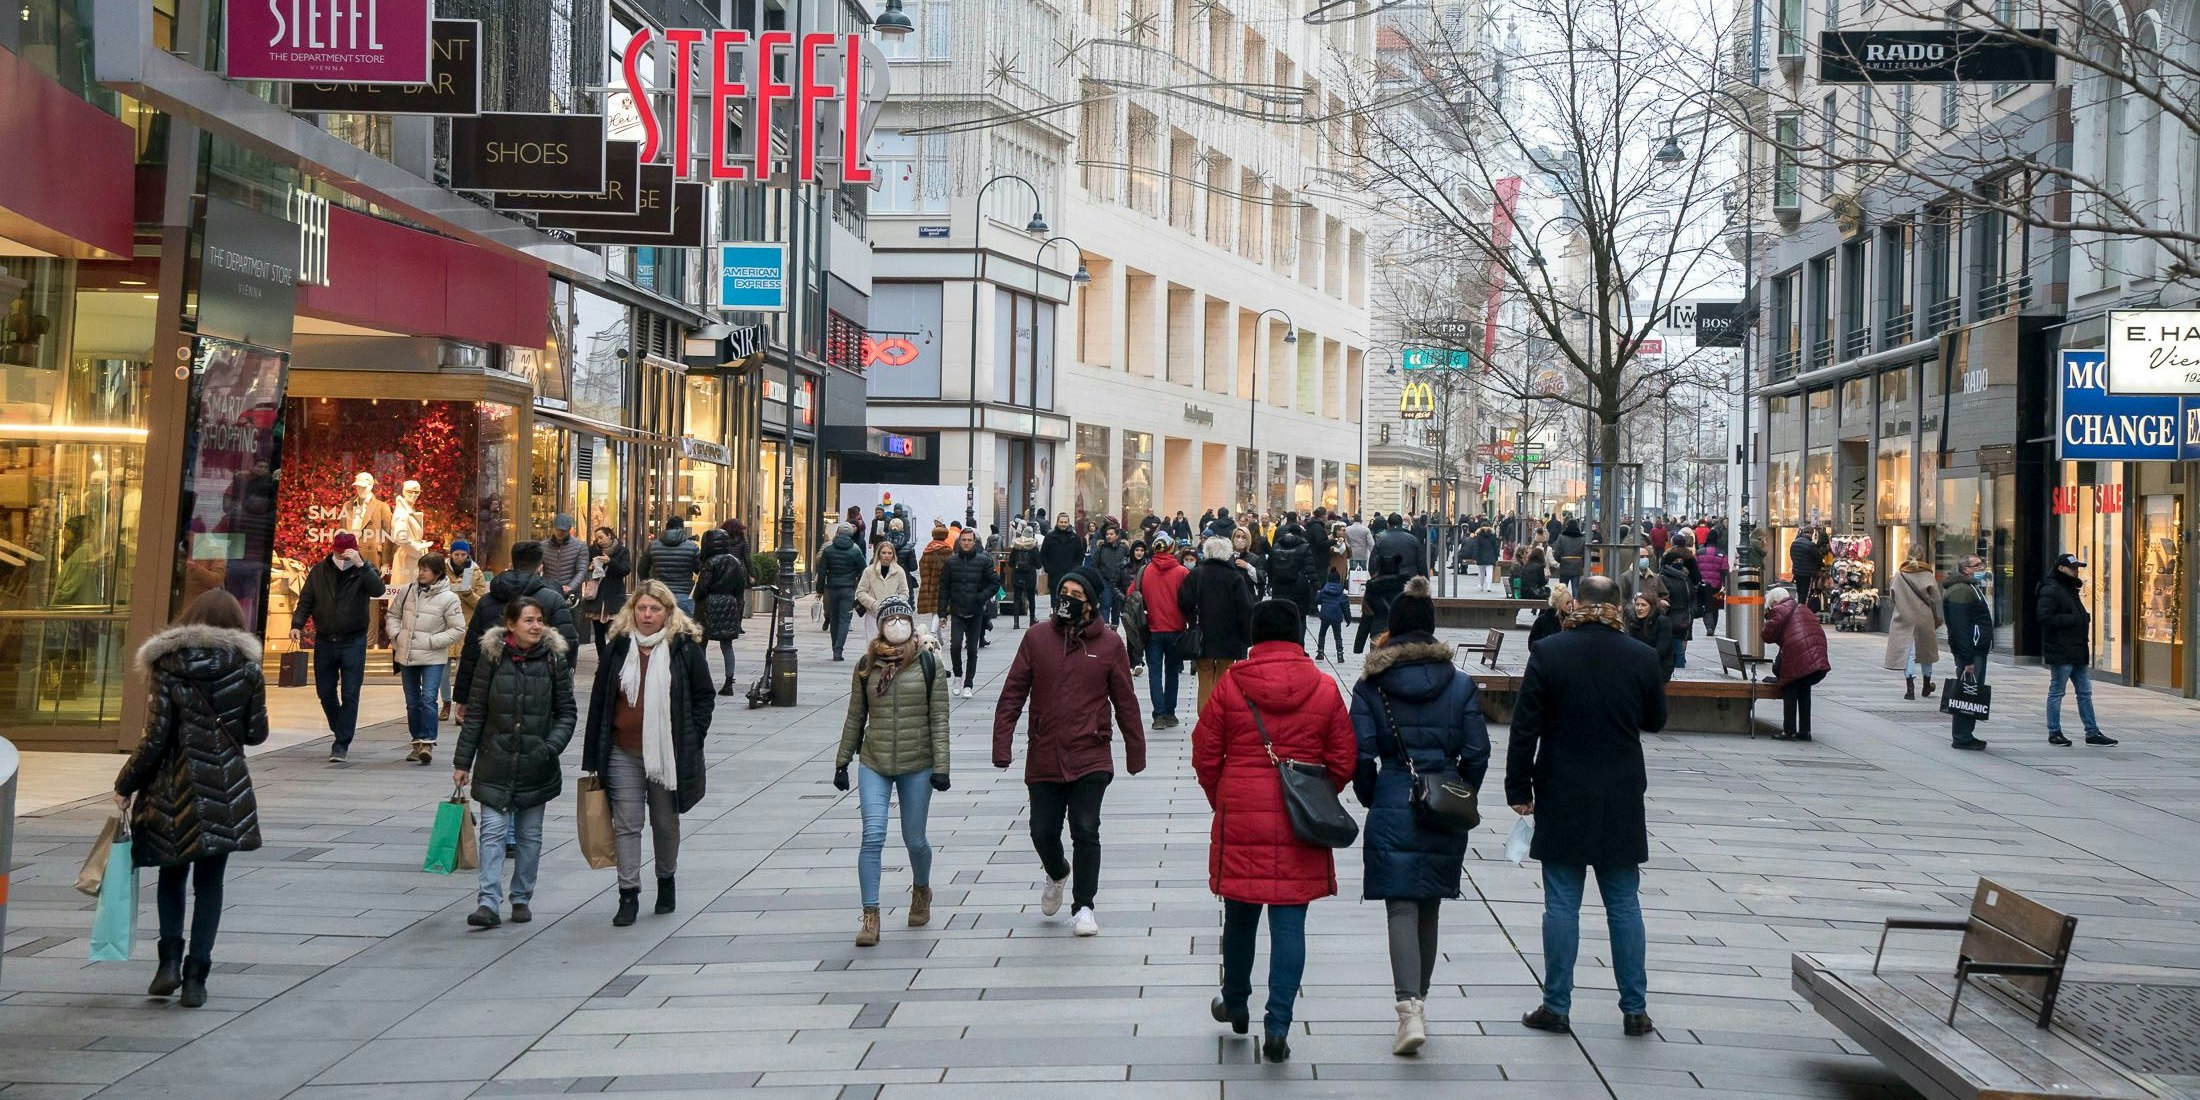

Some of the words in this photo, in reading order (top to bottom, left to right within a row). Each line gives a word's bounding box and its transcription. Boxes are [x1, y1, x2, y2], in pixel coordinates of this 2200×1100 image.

[269, 0, 384, 50] STEFFL
[269, 52, 289, 62] THE
[291, 53, 353, 63] DEPARTMENT
[355, 54, 385, 64] STORE
[1866, 43, 1944, 61] RADO
[622, 27, 872, 182] STEFFL
[486, 141, 569, 164] SHOES
[210, 246, 225, 268] THE
[225, 252, 270, 280] DEPARTMENT
[271, 264, 293, 286] STORE
[724, 267, 779, 278] AMERICAN
[238, 283, 263, 299] VIENNA
[734, 279, 782, 289] EXPRESS
[731, 327, 755, 360] SIR
[2127, 326, 2152, 342] E.
[1963, 368, 1989, 394] RADO
[203, 423, 259, 454] SHOPPING
[2065, 414, 2175, 446] CHANGE
[1851, 476, 1866, 532] IENNA
[2052, 485, 2077, 515] SALE
[2096, 483, 2122, 514] SALE
[1948, 698, 1989, 714] HUMANIC
